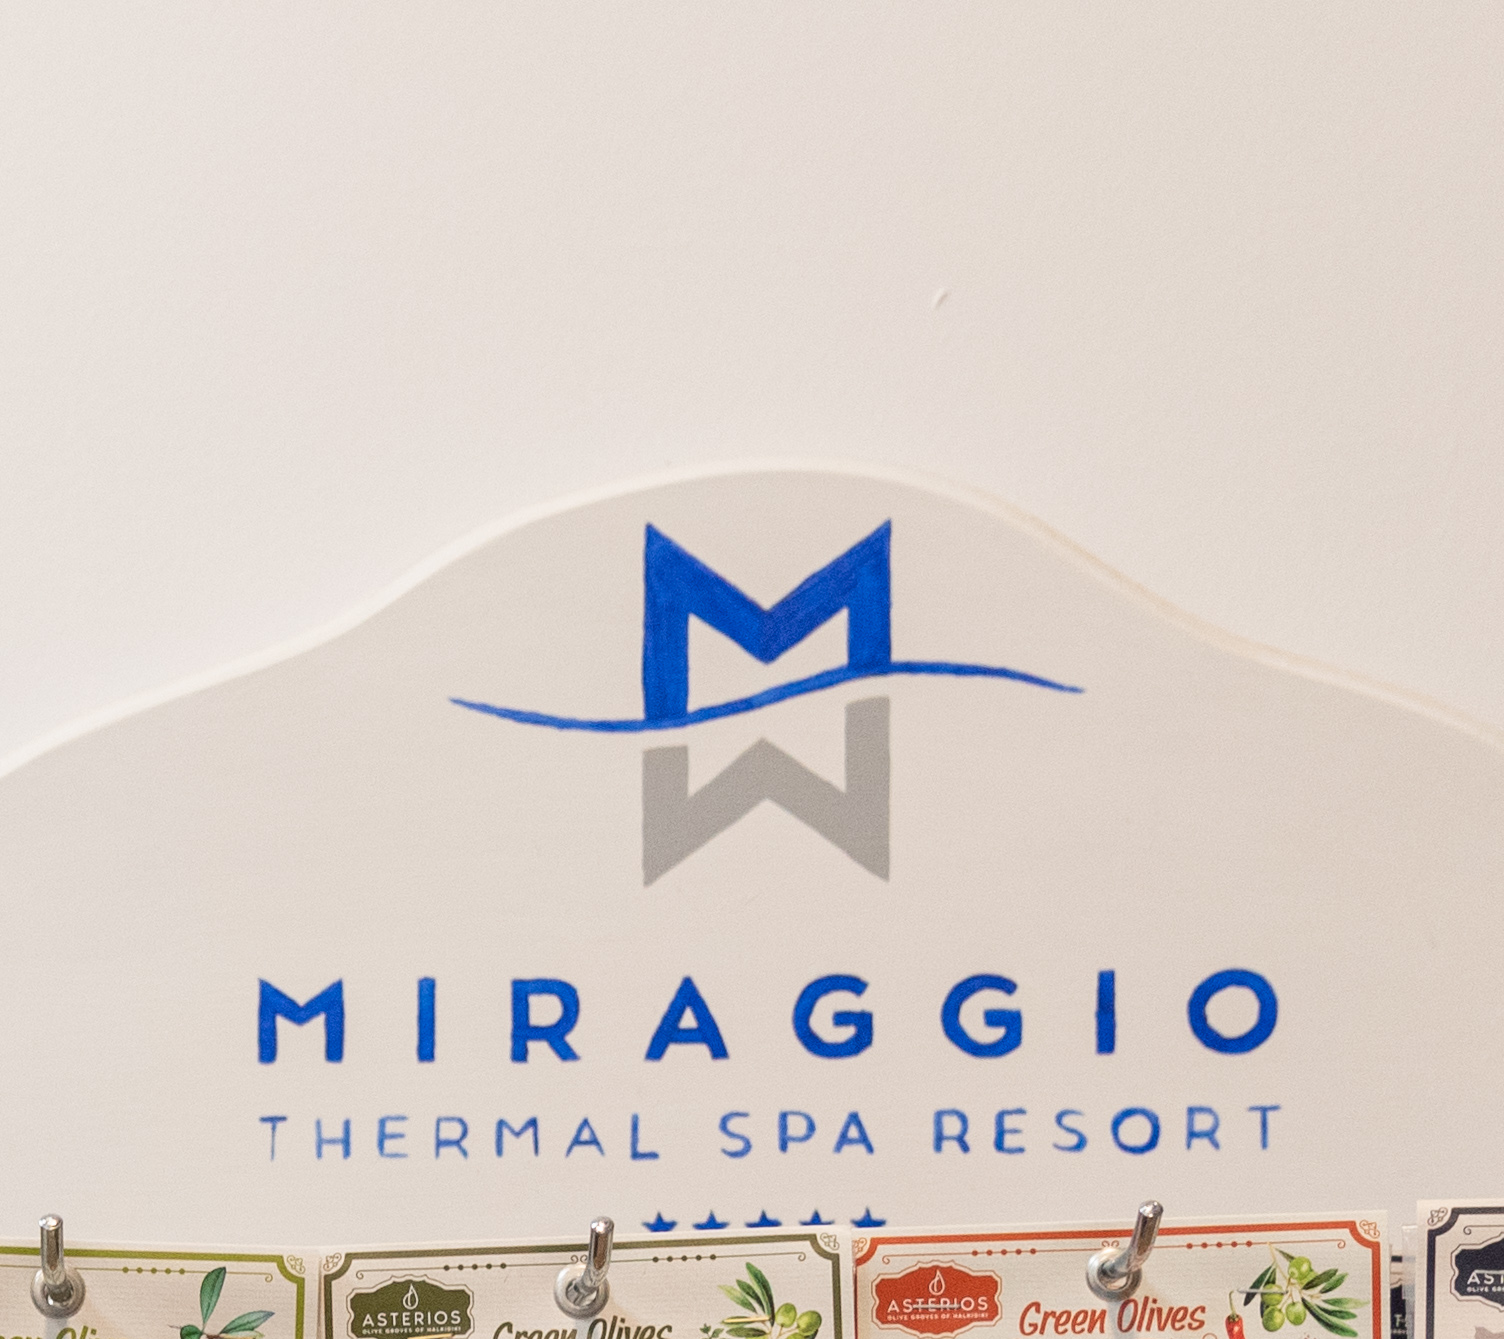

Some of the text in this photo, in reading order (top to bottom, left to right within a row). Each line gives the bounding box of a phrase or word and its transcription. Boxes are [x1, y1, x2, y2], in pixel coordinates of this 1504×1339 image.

[258, 968, 1278, 1064] MIRAGGIO
[259, 1105, 1280, 1161] THERMAL SPA RESORT
[362, 1310, 461, 1327] ASTERIOS
[887, 1296, 989, 1313] ASTERIOS
[1019, 1298, 1206, 1336] Green Olives
